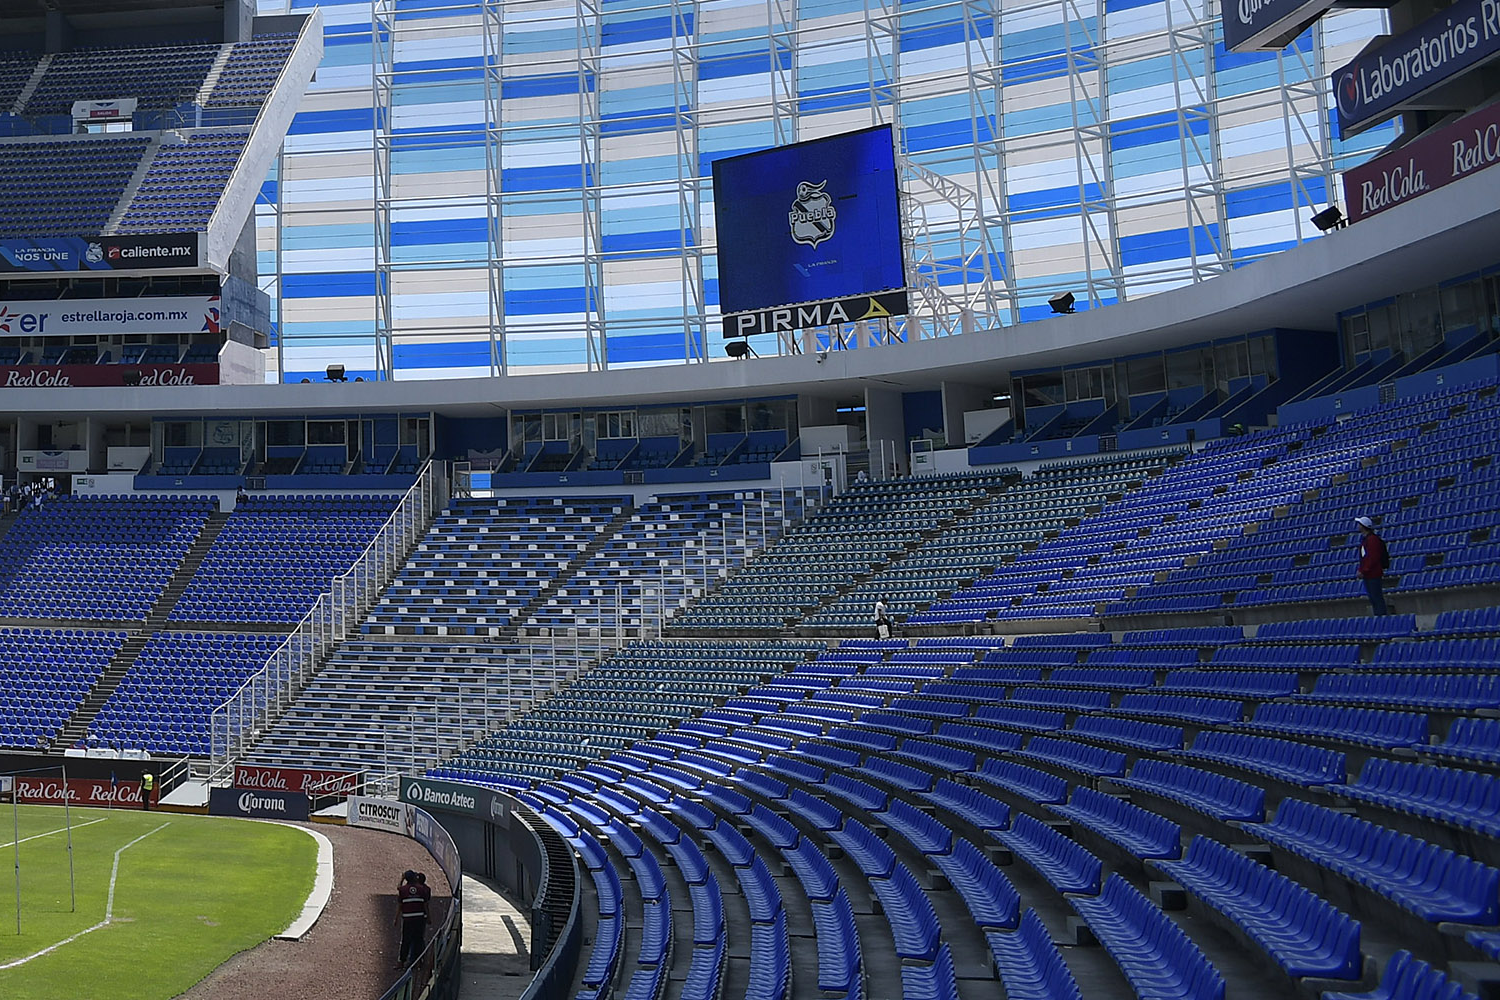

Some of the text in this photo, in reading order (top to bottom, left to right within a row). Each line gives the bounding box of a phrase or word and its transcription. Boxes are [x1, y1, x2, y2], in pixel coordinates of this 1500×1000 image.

[1360, 16, 1479, 105] Laboratorios
[14, 252, 69, 263] NOS UNE
[120, 246, 192, 259] caliente.mx
[19, 313, 48, 333] er
[61, 308, 188, 325] estrellaroja.com.mx
[737, 302, 850, 336] PIRMA
[238, 792, 287, 814] Corona
[424, 787, 475, 809] Banco Azteca
[359, 803, 401, 821] CITROSCUT
